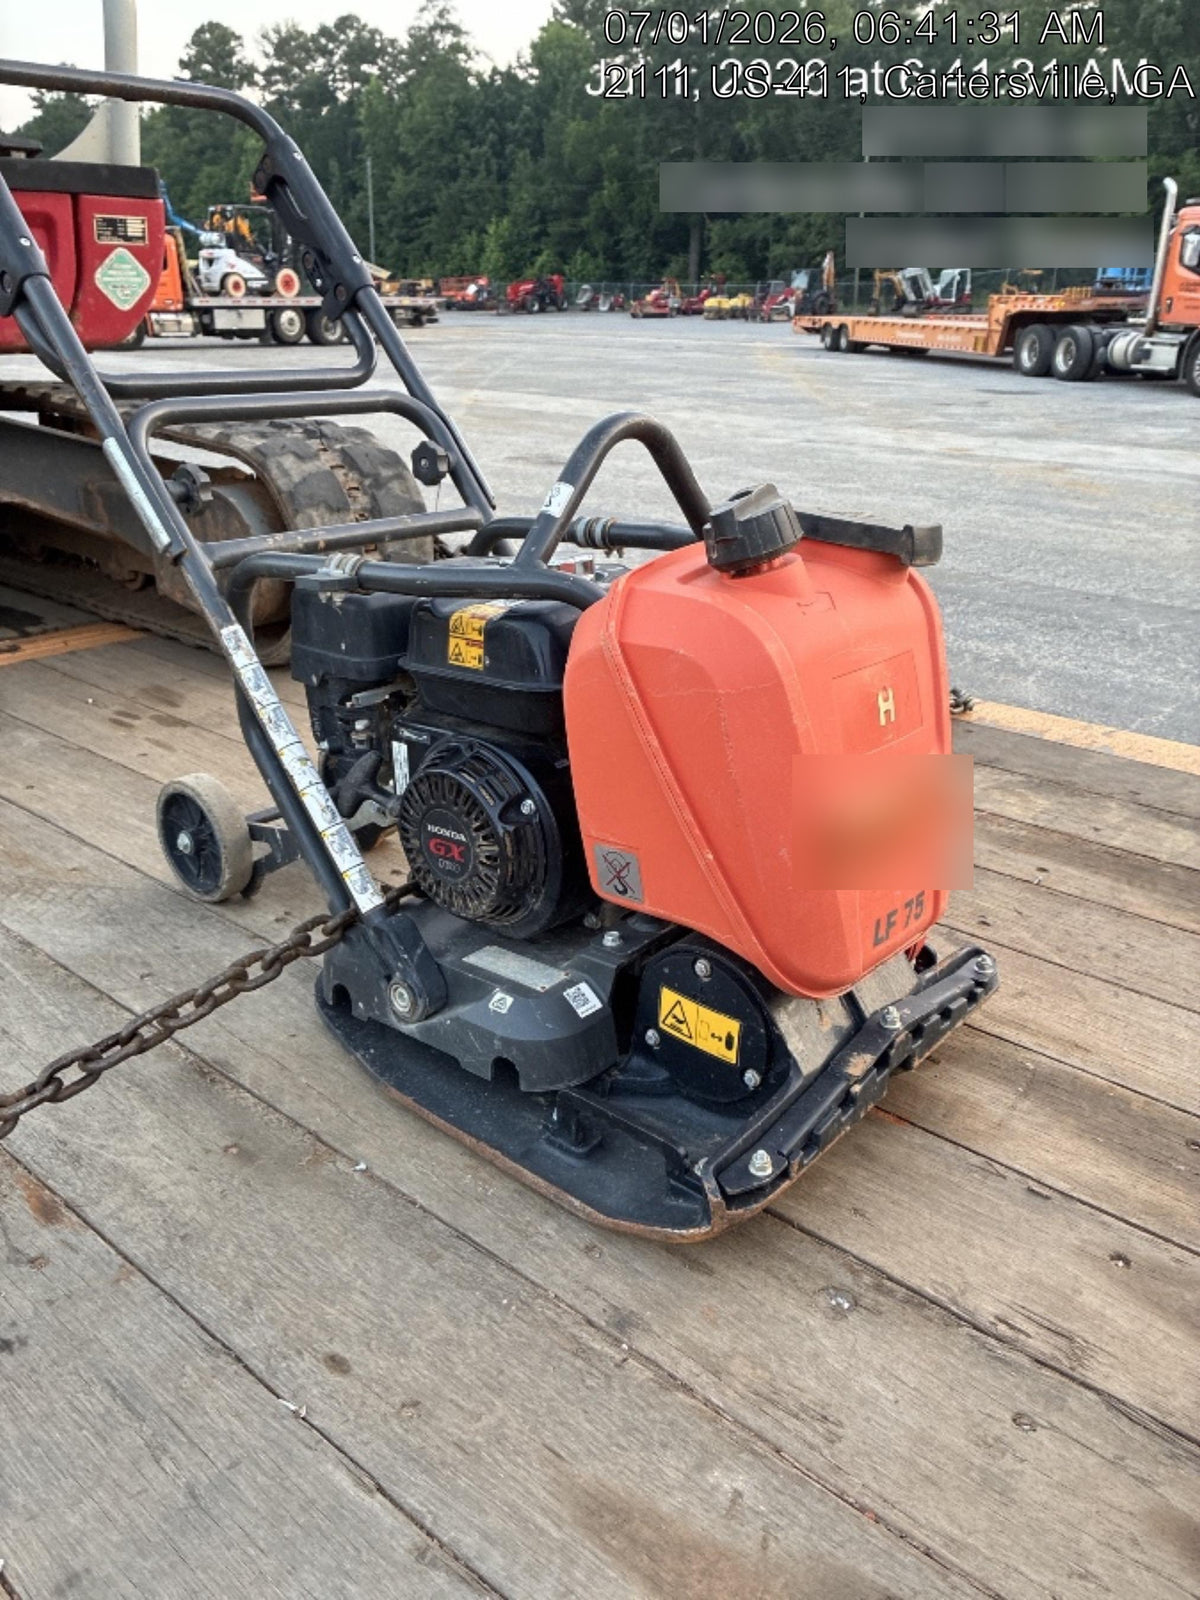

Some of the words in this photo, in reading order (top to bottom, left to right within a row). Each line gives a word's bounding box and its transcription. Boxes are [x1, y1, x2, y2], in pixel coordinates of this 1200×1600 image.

[427, 823, 468, 842] HONDA
[428, 837, 467, 864] GX
[873, 909, 898, 948] LF
[904, 890, 926, 928] 75
